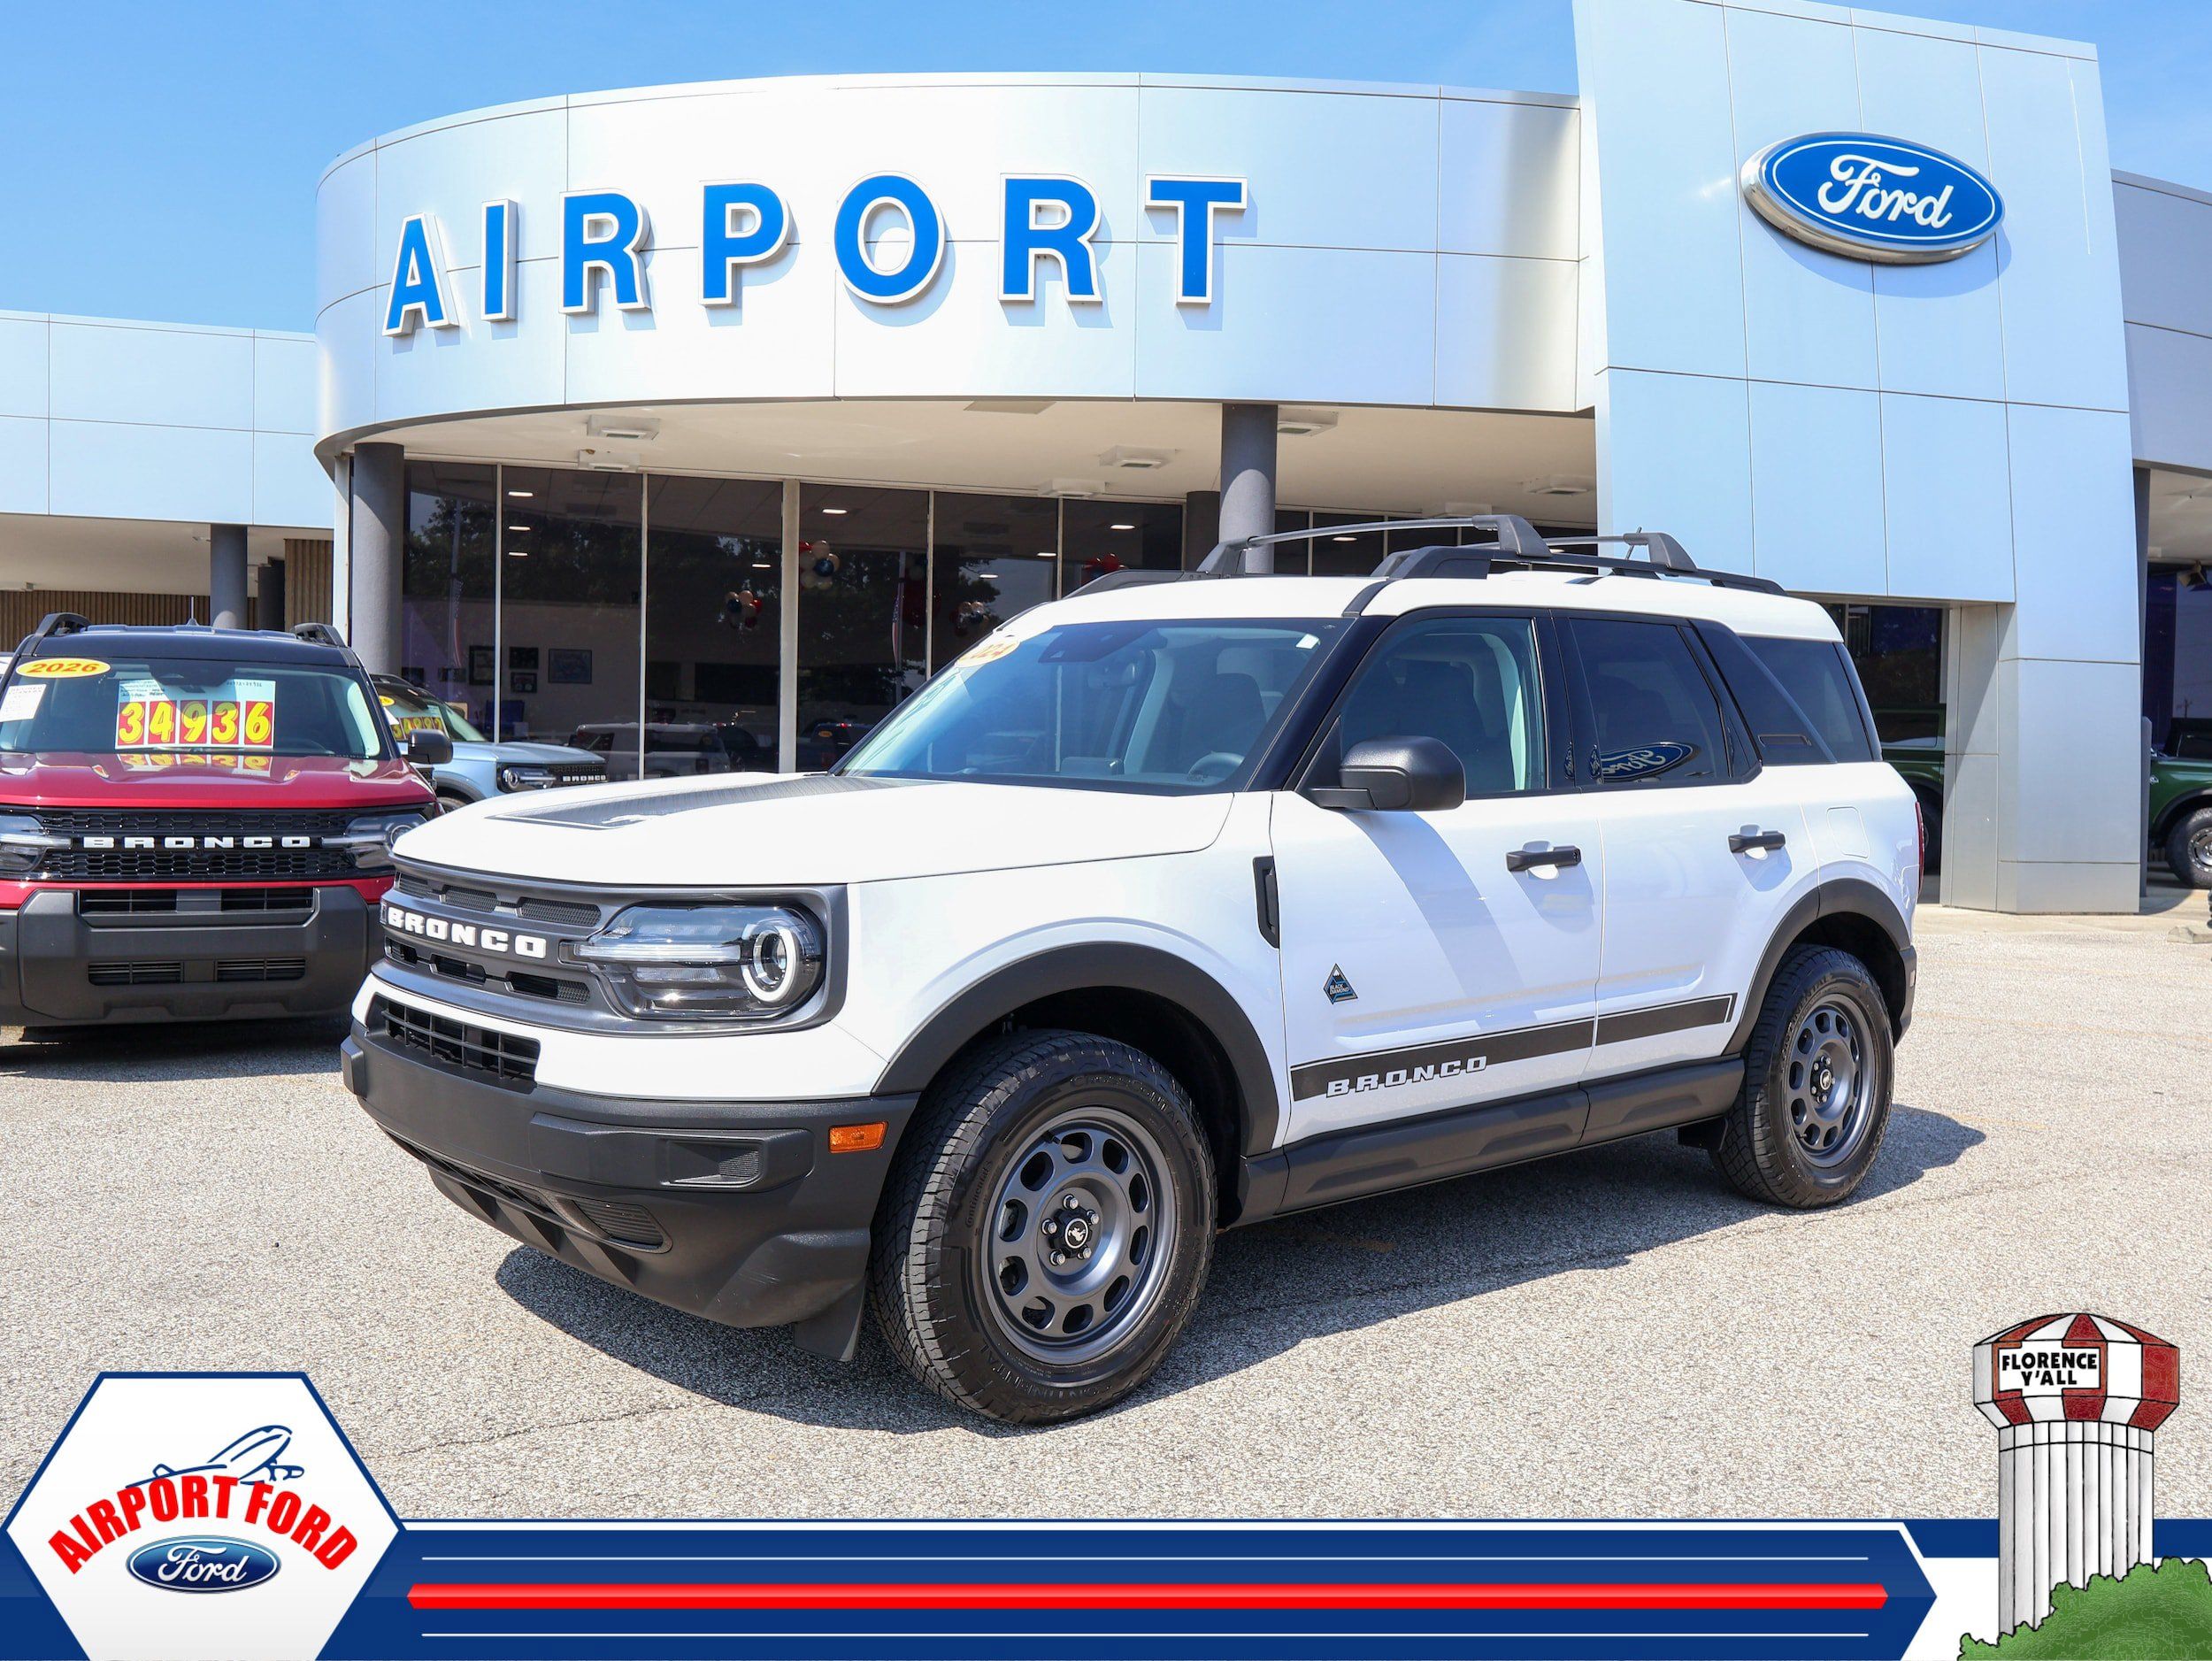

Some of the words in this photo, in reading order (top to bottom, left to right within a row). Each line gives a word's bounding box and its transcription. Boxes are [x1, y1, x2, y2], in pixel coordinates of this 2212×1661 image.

[1818, 153, 1954, 229] Ford
[381, 172, 1248, 337] AIRPORT
[27, 662, 100, 674] 2026
[119, 701, 271, 743] 34936
[83, 835, 311, 849] BRONCO
[388, 906, 547, 959] BRONCO
[1326, 1056, 1487, 1098] BRONCO
